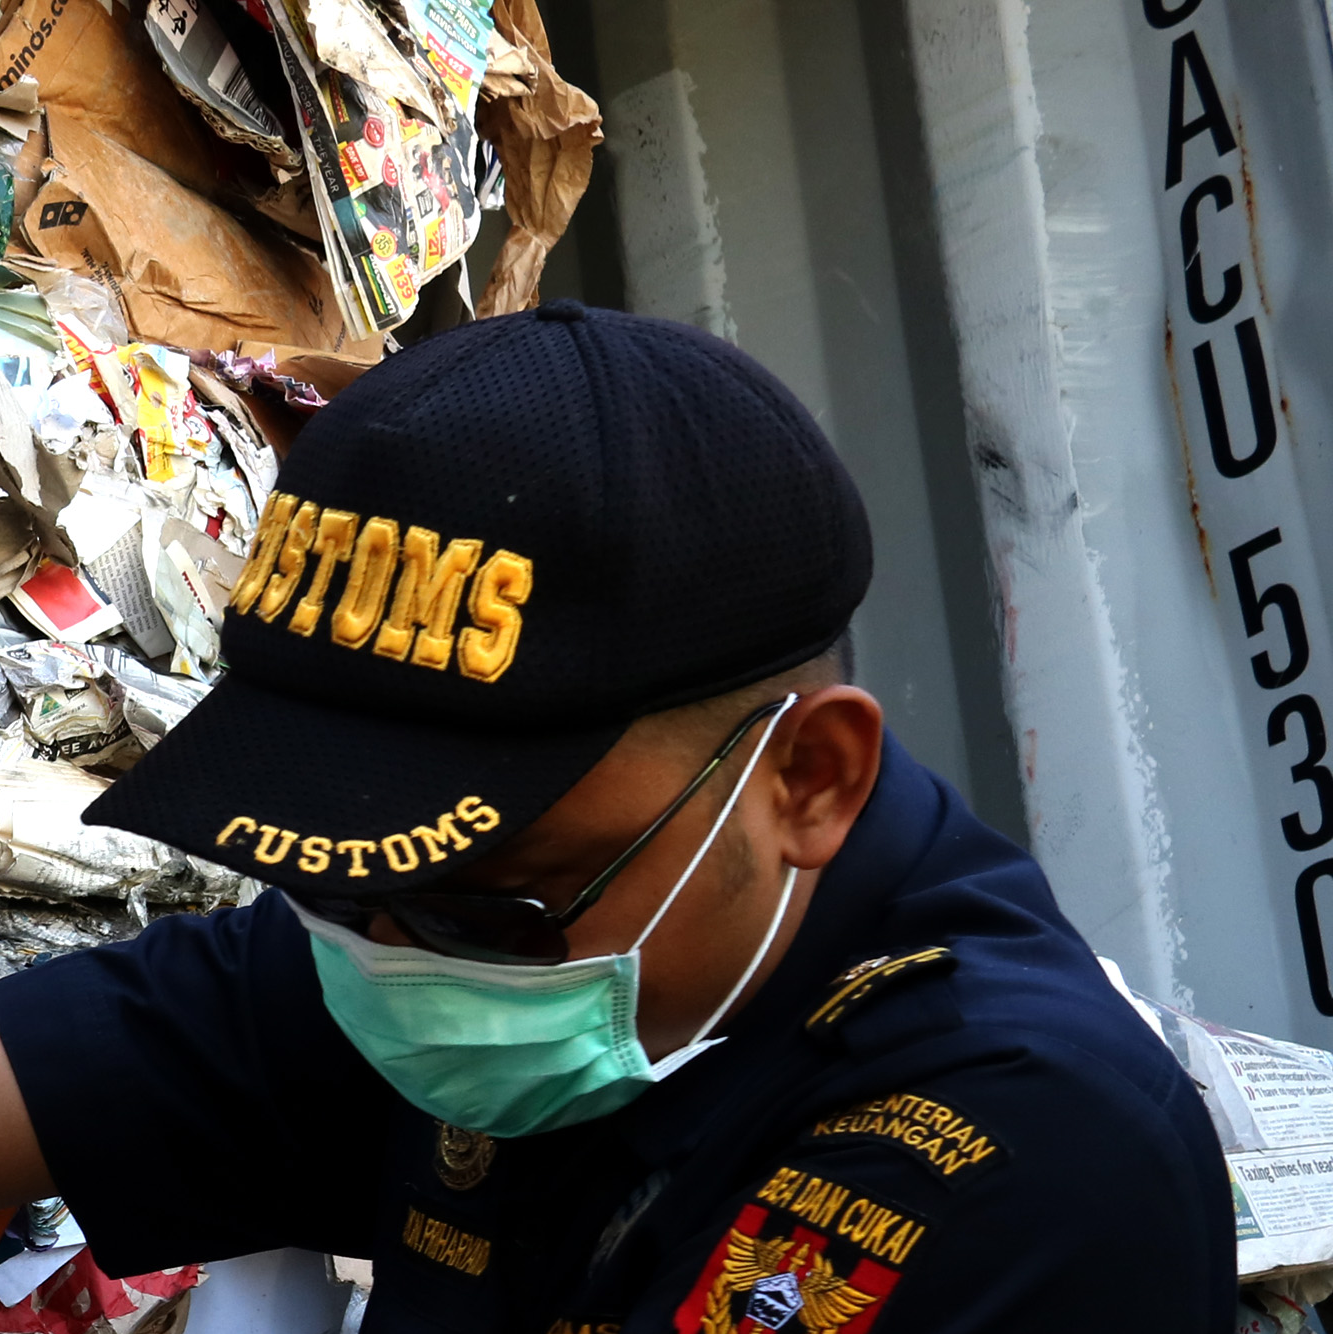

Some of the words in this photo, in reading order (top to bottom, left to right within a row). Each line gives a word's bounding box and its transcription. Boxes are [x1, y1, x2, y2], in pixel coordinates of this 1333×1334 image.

[453, 12, 478, 41] PARTS
[321, 160, 340, 194] YEAR
[1141, 0, 1280, 478] ACU
[395, 262, 413, 300] $139
[216, 794, 502, 879] CUSTOMS
[813, 1115, 968, 1175] KEUANGAN
[1238, 1164, 1275, 1183] Taxing
[1271, 1161, 1300, 1179] times
[1297, 1159, 1314, 1176] for
[757, 1167, 808, 1208] BEA
[790, 1177, 851, 1228] DAN
[837, 1198, 926, 1265] CUKAI
